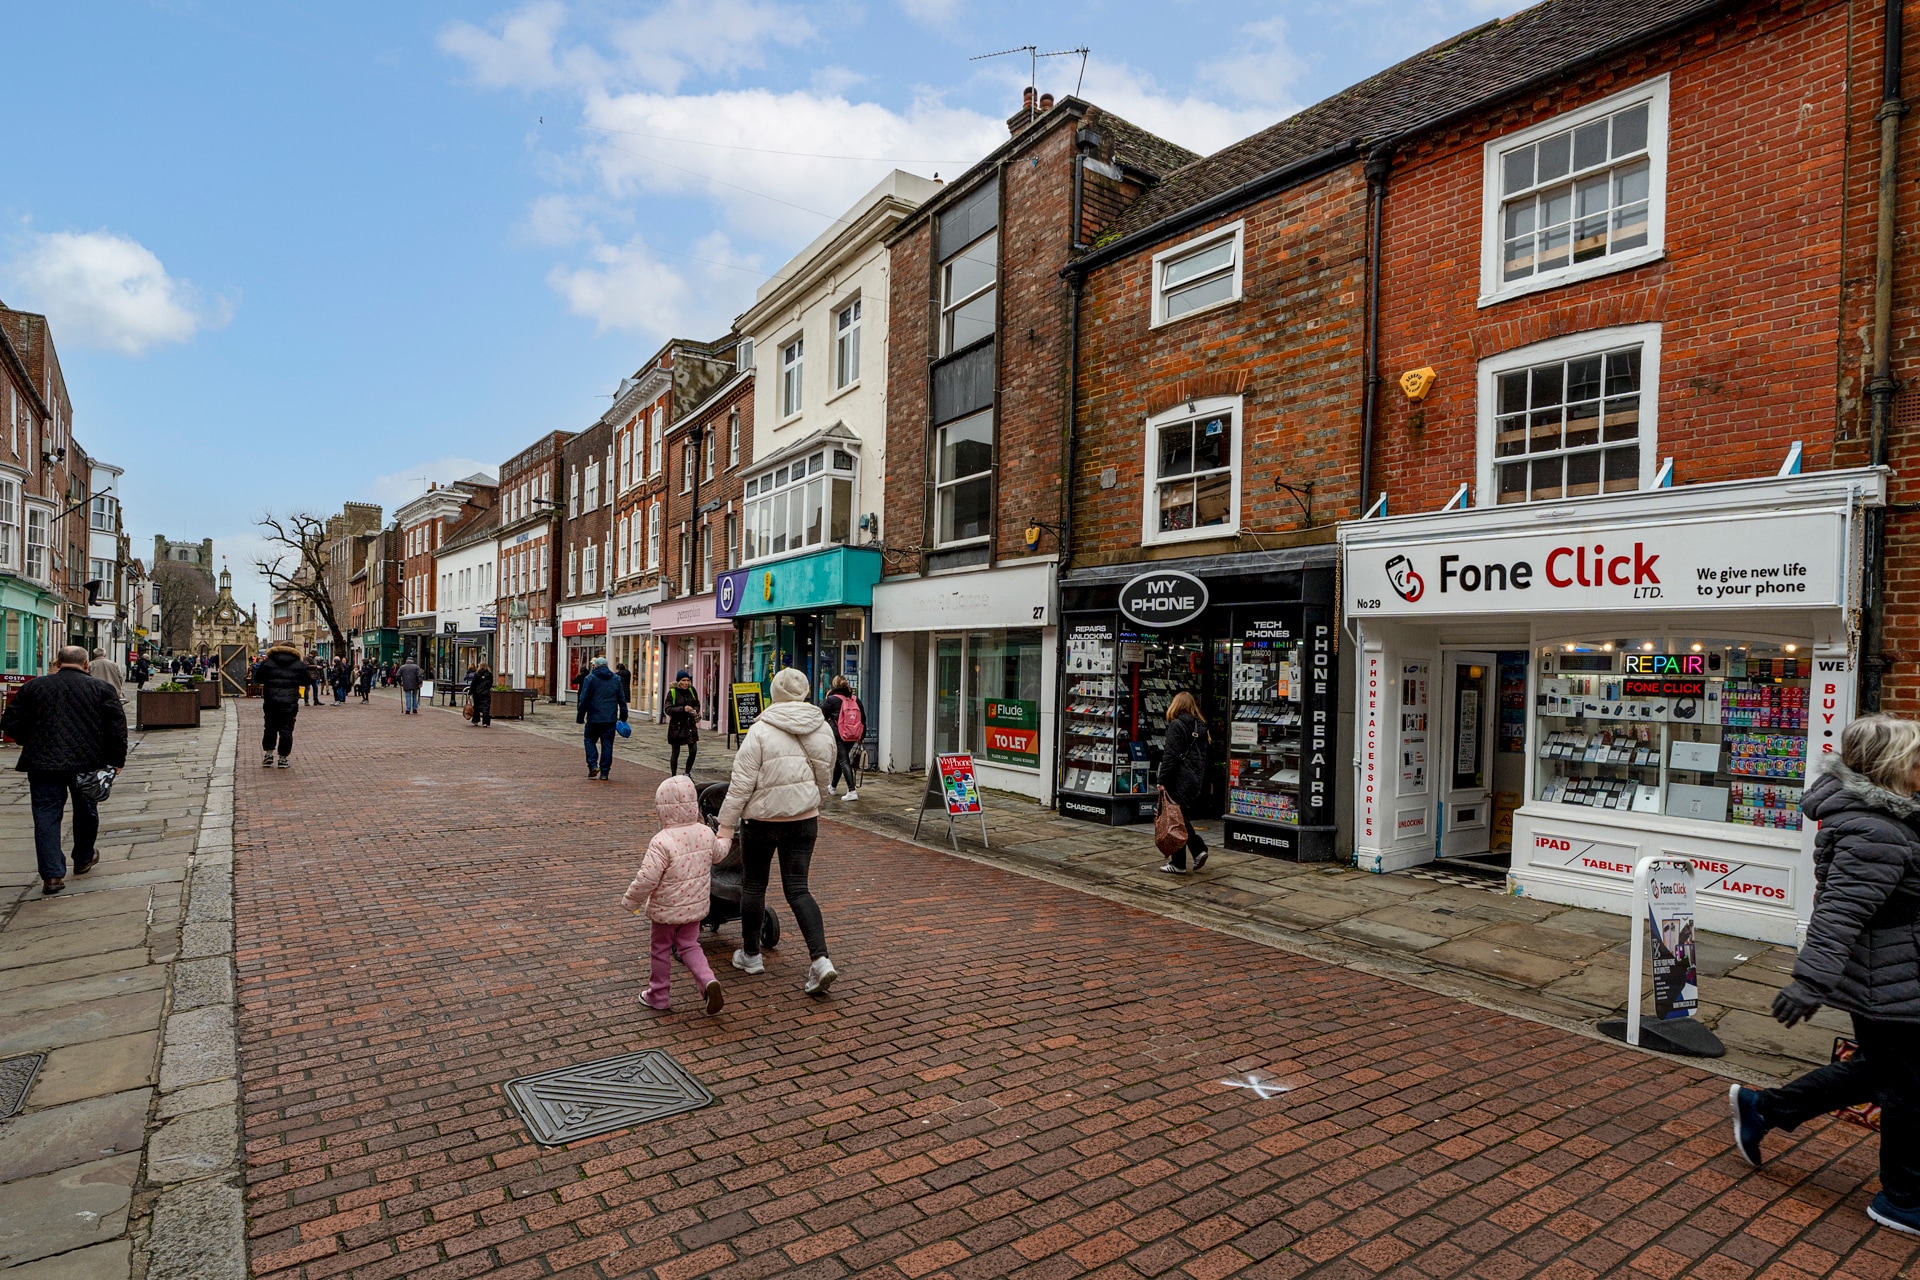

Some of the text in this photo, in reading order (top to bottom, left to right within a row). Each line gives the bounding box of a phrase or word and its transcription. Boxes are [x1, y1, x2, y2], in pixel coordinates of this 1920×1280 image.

[1440, 542, 1661, 593] Fone Click
[1697, 563, 1807, 583] We give new life
[1147, 580, 1177, 594] MY
[1633, 587, 1664, 598] LTD.
[1697, 580, 1806, 598] to your phone
[1131, 596, 1195, 611] PHONE
[1033, 607, 1044, 619] 27
[1254, 621, 1282, 629] TECH
[1069, 632, 1113, 640] UNLOCKING
[1246, 630, 1290, 638] PHONES
[1626, 655, 1703, 674] REPAIR
[1819, 661, 1844, 672] WE
[1626, 682, 1702, 694] FONE CLICK
[997, 704, 1023, 716] Flude
[1823, 683, 1836, 725] BUY
[1310, 625, 1328, 807] PHONE REPAIRS
[995, 734, 1027, 750] TO LET
[1366, 659, 1377, 836] PHONE ACCESSORIES
[1065, 802, 1106, 815] CHARGERS
[1398, 818, 1424, 829] UNLOCKING
[1233, 832, 1290, 848] BATTERIES
[1536, 837, 1571, 851] iPAD
[1582, 858, 1633, 873] TABLET
[1660, 882, 1687, 894] Fone Click
[1722, 879, 1786, 900] LAPTOS
